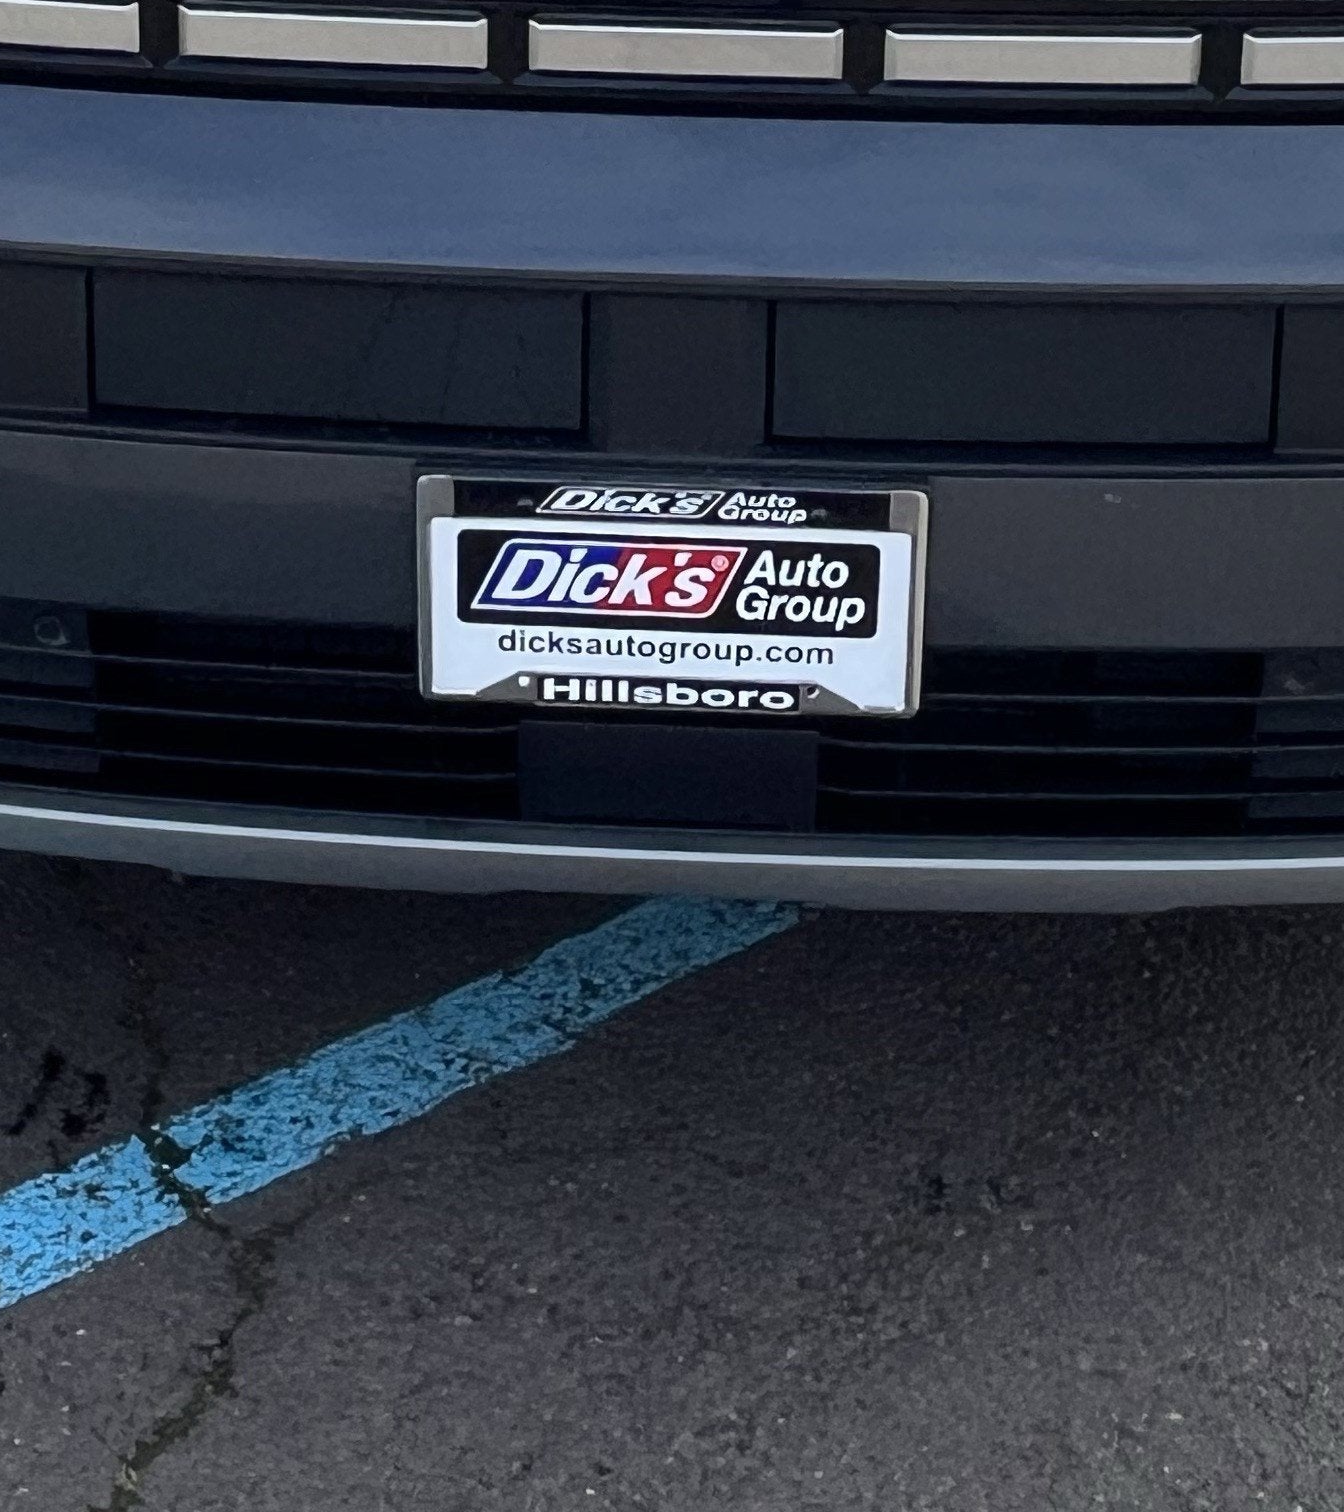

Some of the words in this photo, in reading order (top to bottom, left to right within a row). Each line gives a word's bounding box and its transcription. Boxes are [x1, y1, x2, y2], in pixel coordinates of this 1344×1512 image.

[550, 488, 713, 515] Dick's
[724, 491, 797, 508] Auto
[717, 507, 808, 525] Group
[491, 547, 718, 608] Dick's
[744, 549, 850, 588] Auto
[736, 589, 866, 632] Group
[498, 629, 834, 667] dicksautogroup.com
[543, 677, 796, 710] Hillsboro
